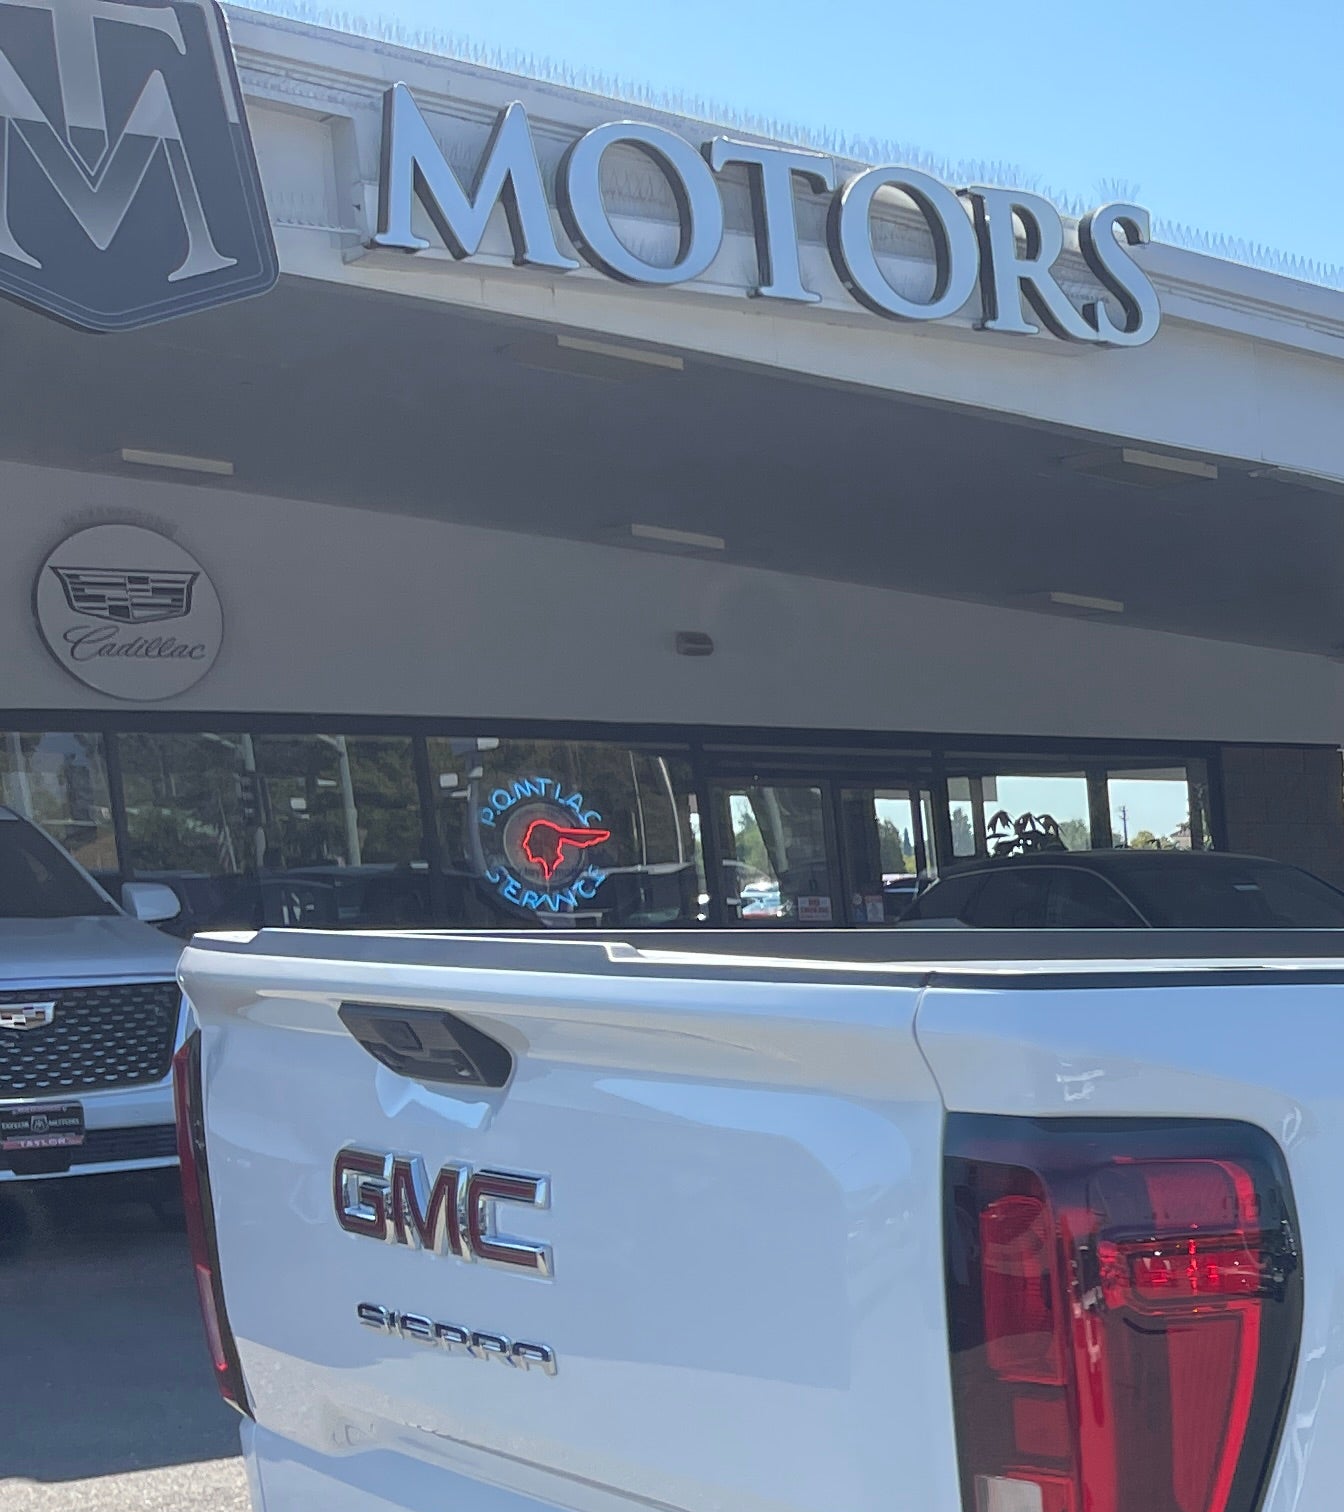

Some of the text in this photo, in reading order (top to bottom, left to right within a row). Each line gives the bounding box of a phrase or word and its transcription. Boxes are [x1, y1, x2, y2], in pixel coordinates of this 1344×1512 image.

[372, 81, 1162, 348] MOTORS
[62, 624, 206, 662] Cadillac
[481, 776, 602, 828] PONTIAC
[484, 863, 608, 912] SERVICE
[334, 1143, 554, 1280] GMC
[357, 1302, 558, 1376] SIERRA
